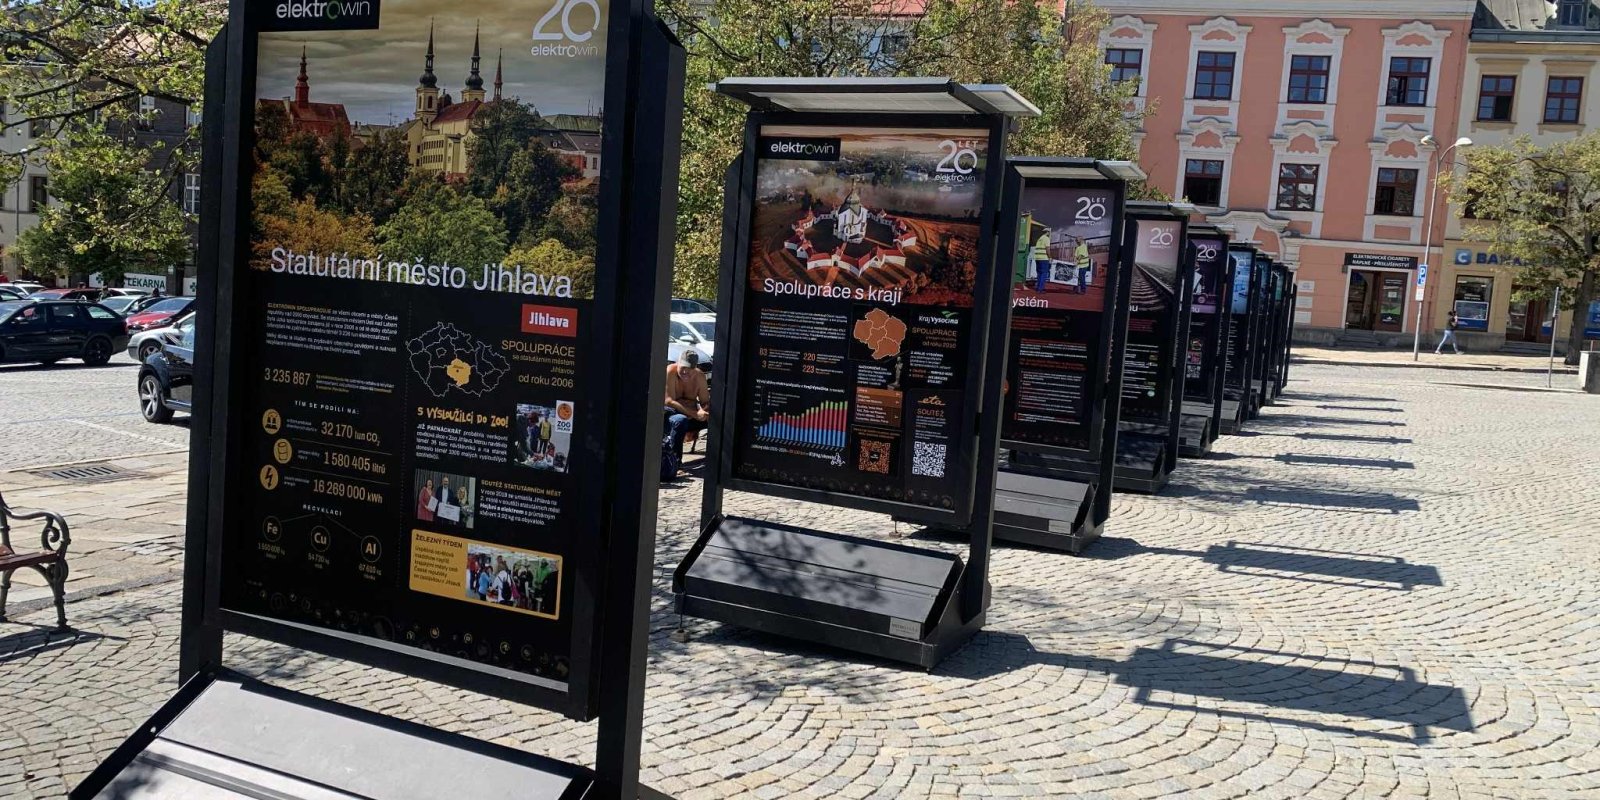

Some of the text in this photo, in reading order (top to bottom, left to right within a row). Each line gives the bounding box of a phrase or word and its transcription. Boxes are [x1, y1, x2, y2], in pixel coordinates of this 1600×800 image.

[276, 0, 370, 19] elektrowin
[532, 0, 600, 42] 20
[531, 44, 598, 57] elektrowin
[771, 142, 834, 156] elektrowin
[958, 140, 978, 148] LET
[936, 140, 978, 174] 20
[934, 174, 976, 182] elektrowin
[1075, 197, 1106, 221] 20
[1150, 227, 1173, 245] 20
[1197, 244, 1216, 259] 20
[270, 247, 572, 298] Statutární město Jihlava
[764, 278, 902, 306] Spolupráce s kraji
[1012, 296, 1048, 308] ystém
[529, 311, 569, 328] Jihlava
[502, 340, 575, 358] SPOLUPRÁCE
[264, 368, 270, 380] 3
[272, 368, 290, 383] 235
[292, 371, 310, 386] 867
[531, 375, 550, 385] roku
[551, 377, 574, 388] 2006
[417, 406, 424, 416] S
[321, 421, 334, 436] 32
[336, 424, 353, 439] 170
[324, 452, 330, 464] 1
[332, 453, 350, 468] 580
[352, 456, 371, 472] 405
[313, 479, 325, 493] 16
[326, 481, 345, 497] 269
[346, 485, 366, 500] 000
[367, 492, 383, 504] kWh
[266, 522, 278, 535] Fe
[314, 532, 327, 545] Cu
[416, 534, 463, 548] ŽELEZNÝ TÝDEN
[365, 543, 376, 555] Al
